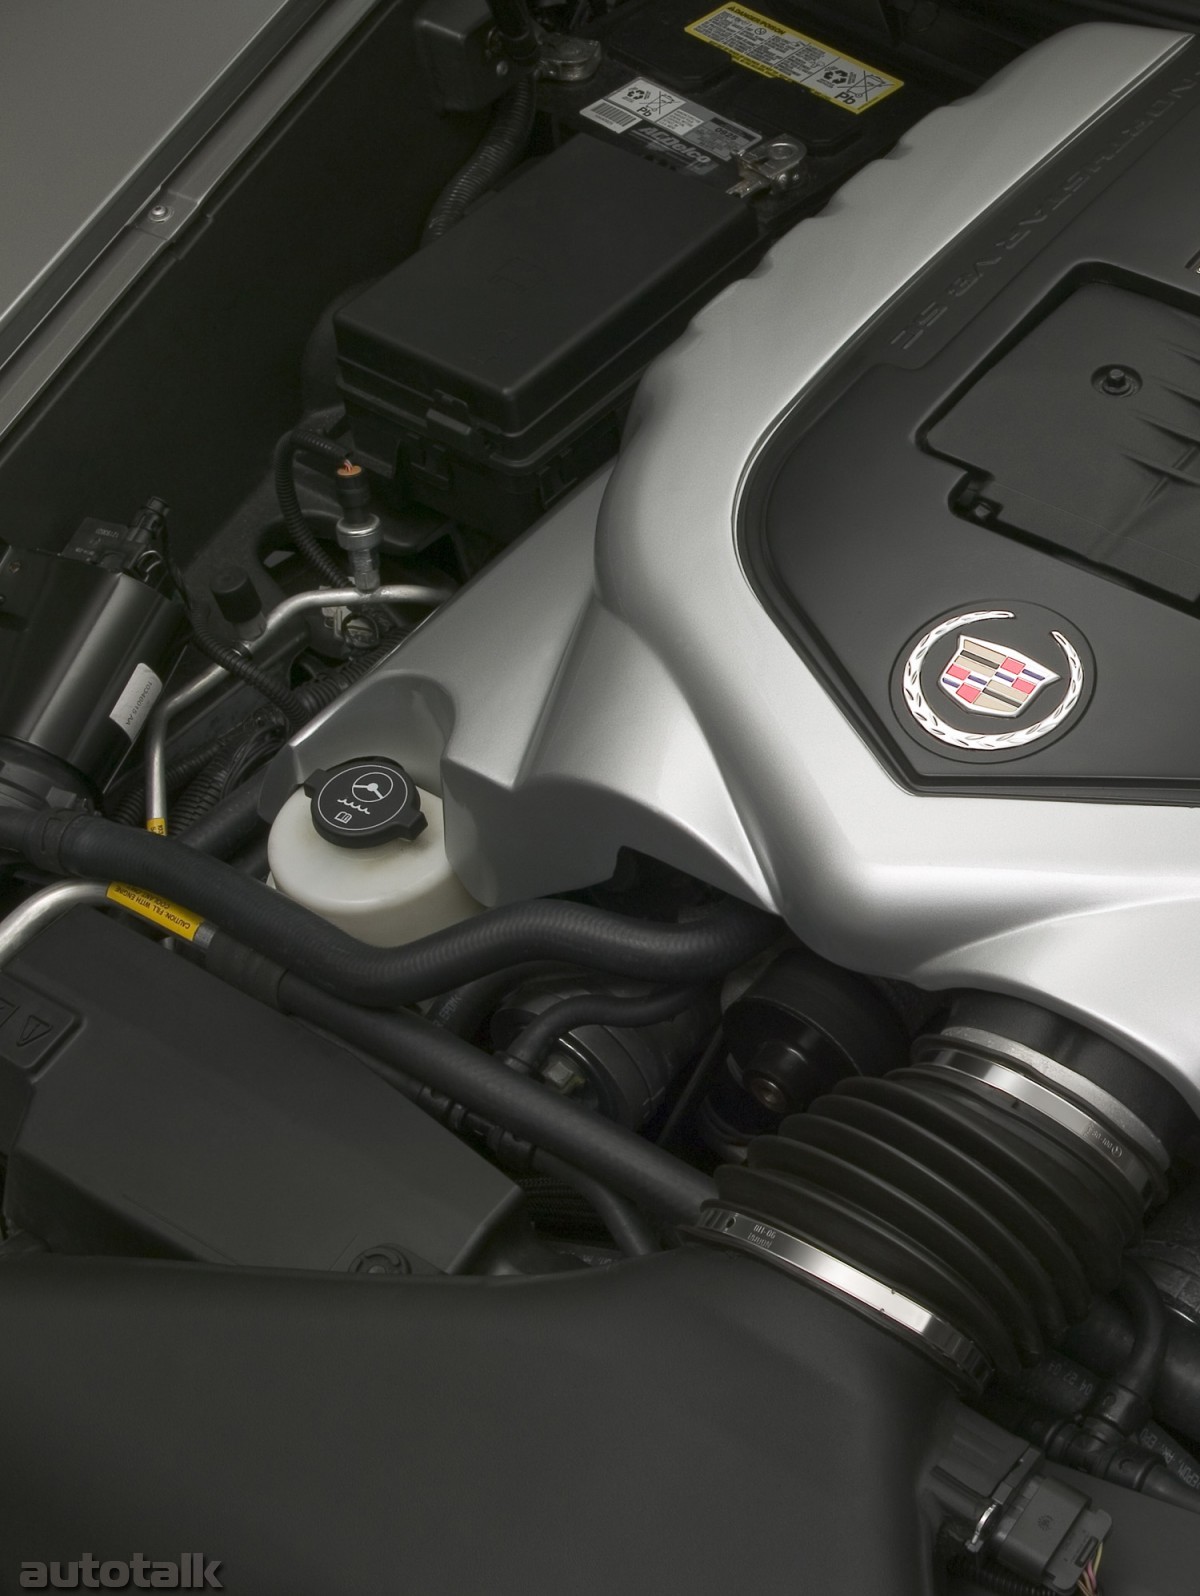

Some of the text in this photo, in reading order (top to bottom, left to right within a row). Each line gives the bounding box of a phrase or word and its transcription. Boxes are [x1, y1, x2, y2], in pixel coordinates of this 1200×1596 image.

[835, 91, 857, 105] Pb
[636, 106, 653, 118] Pb
[638, 125, 711, 164] ACDelco
[115, 886, 135, 900] ENGINE
[135, 896, 151, 908] WITH
[153, 905, 164, 915] FILL
